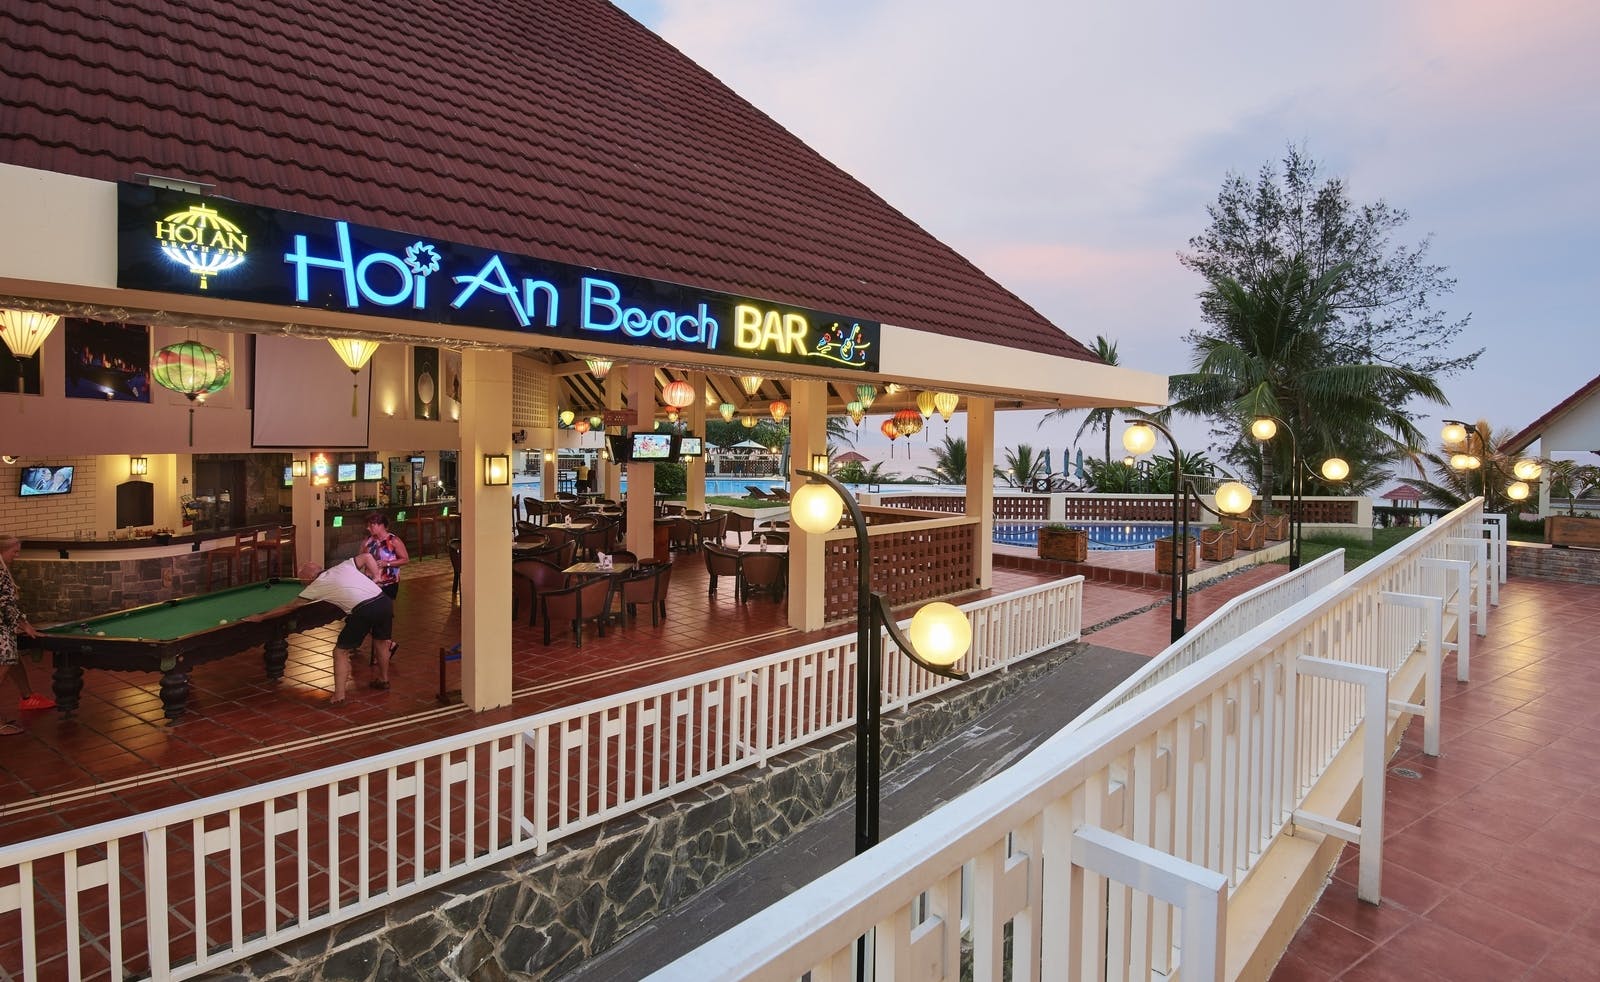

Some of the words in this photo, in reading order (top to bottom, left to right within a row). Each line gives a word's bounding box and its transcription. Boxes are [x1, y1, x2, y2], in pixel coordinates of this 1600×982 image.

[155, 221, 204, 245] HOI
[210, 230, 248, 252] AN
[161, 240, 209, 253] BEACH
[218, 249, 245, 258] BAR
[284, 221, 441, 309] Hoi
[452, 255, 559, 328] An
[581, 277, 719, 350] Beach
[734, 304, 808, 356] BAR
